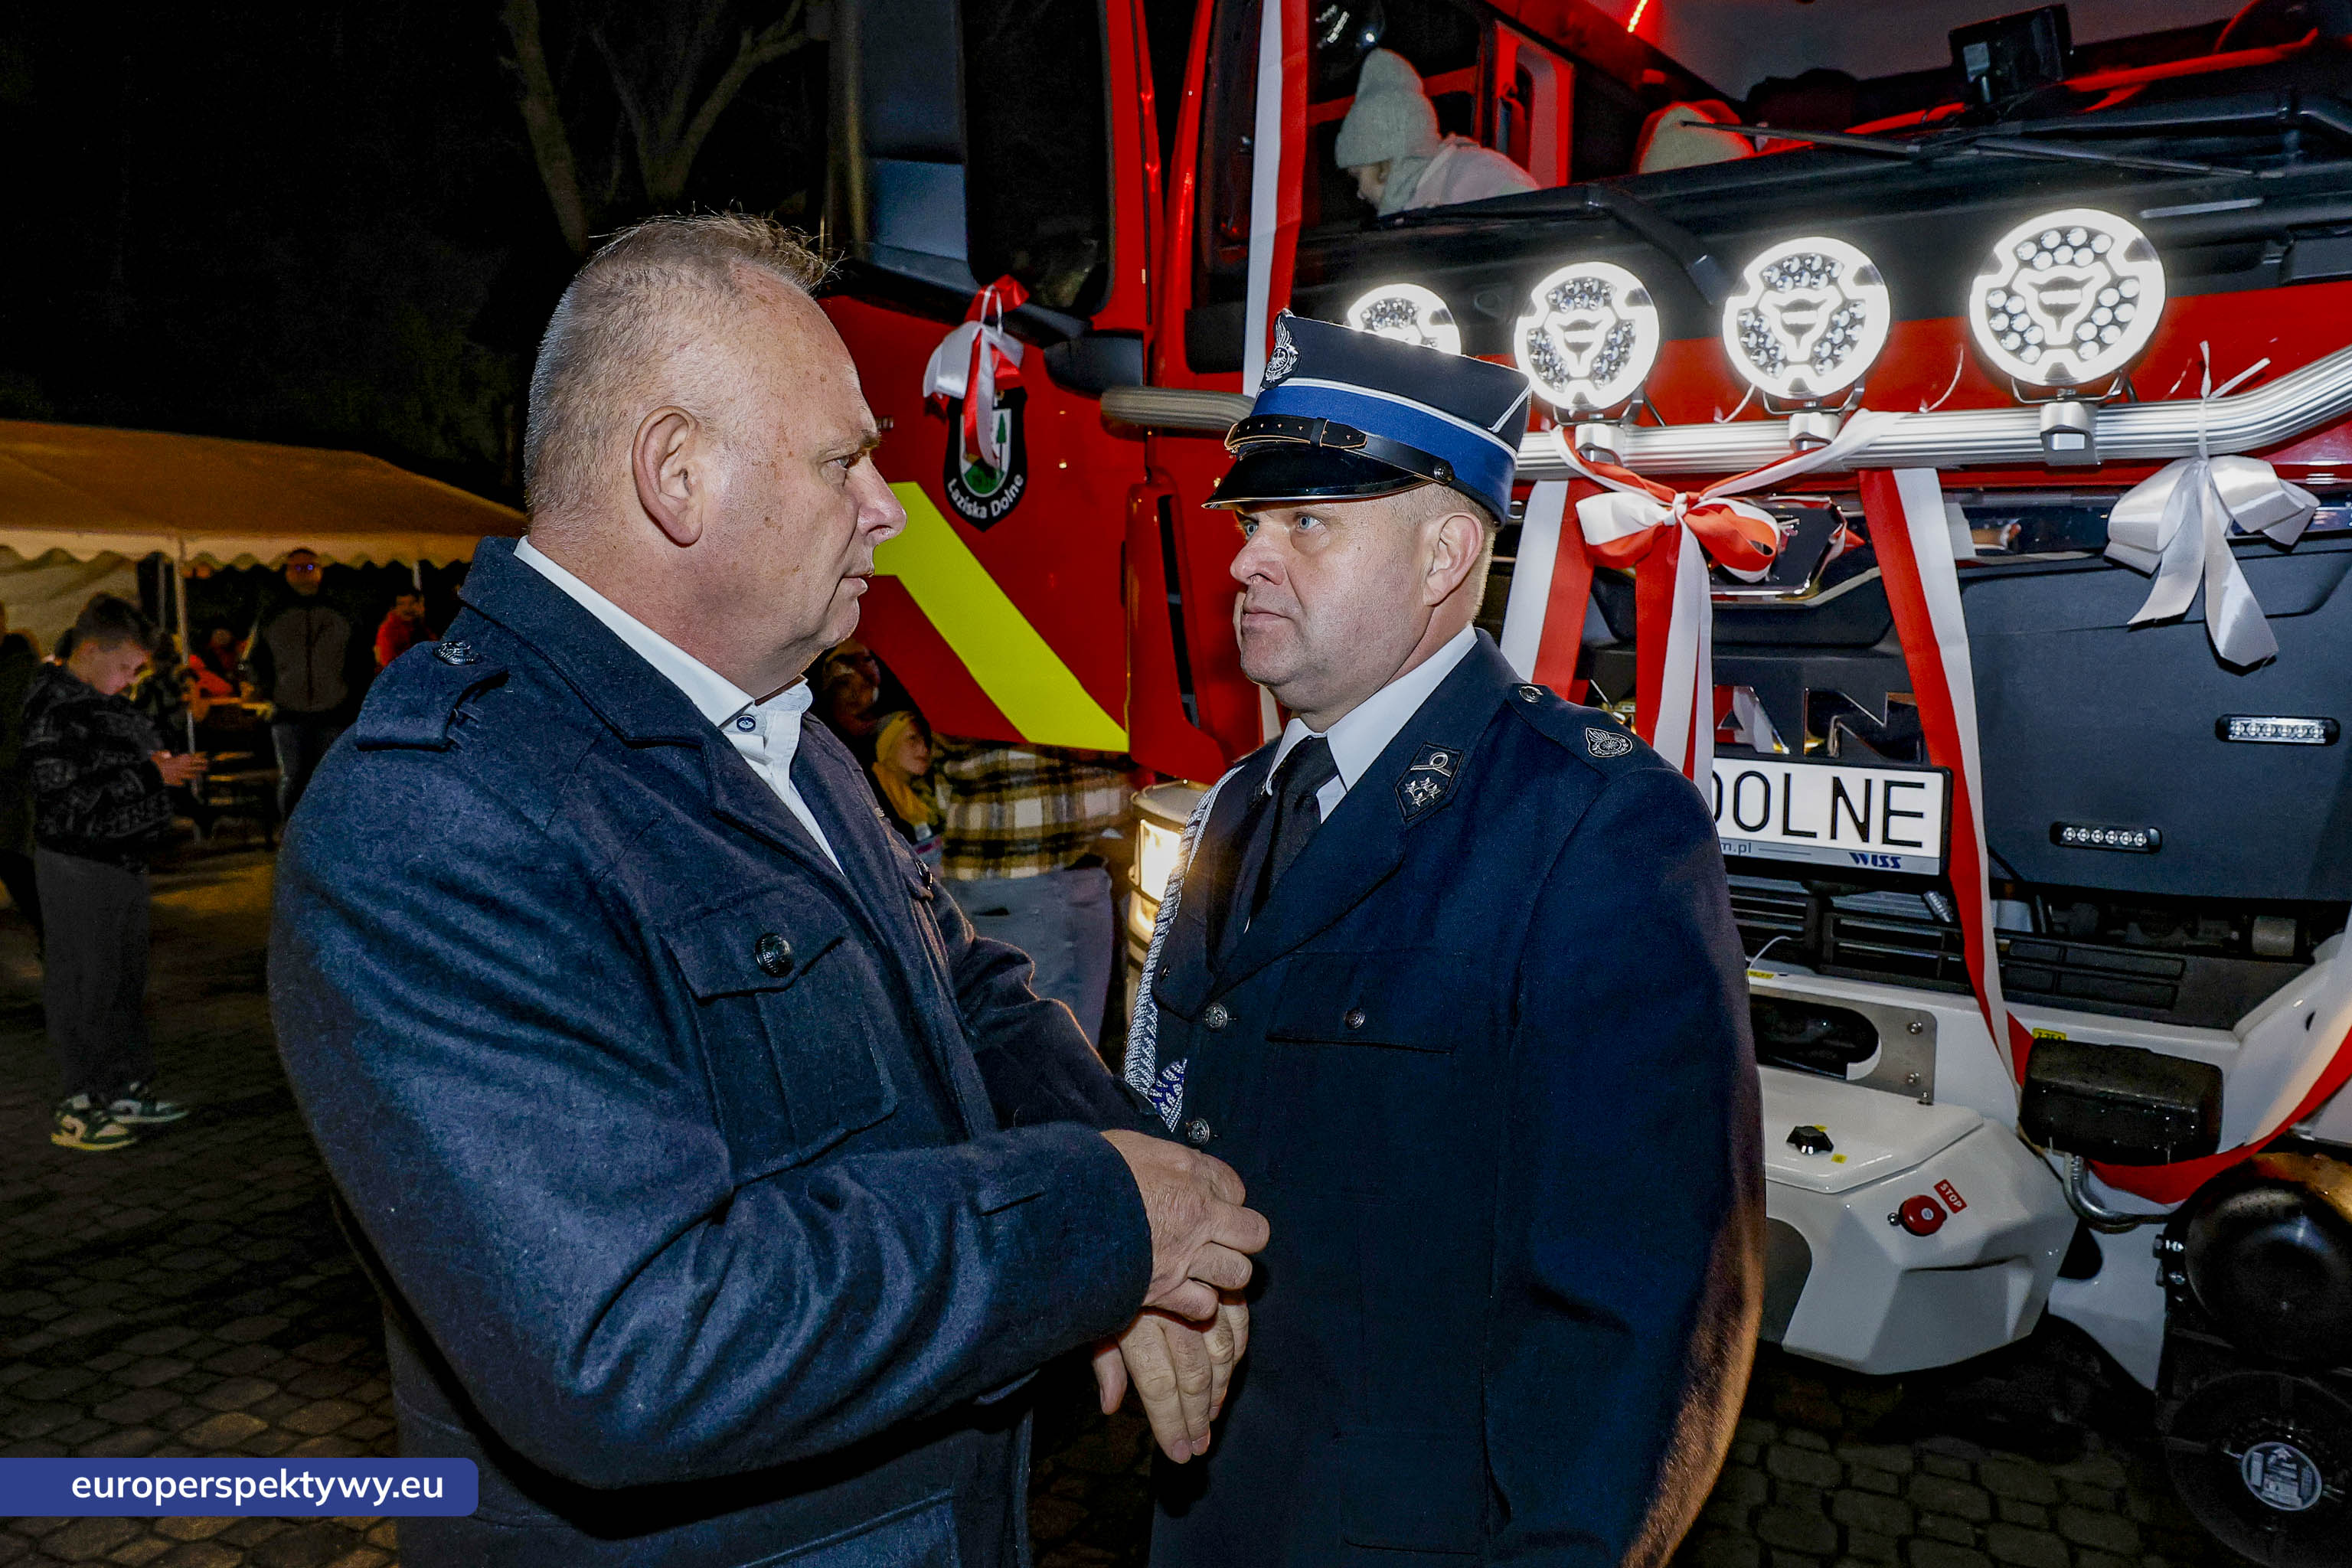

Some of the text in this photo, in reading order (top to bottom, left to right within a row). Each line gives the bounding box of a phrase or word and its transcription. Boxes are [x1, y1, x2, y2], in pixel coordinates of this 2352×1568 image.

[990, 474, 1024, 517] Dolne
[1713, 770, 1925, 848] OLNE
[1939, 1183, 1963, 1208] STOP
